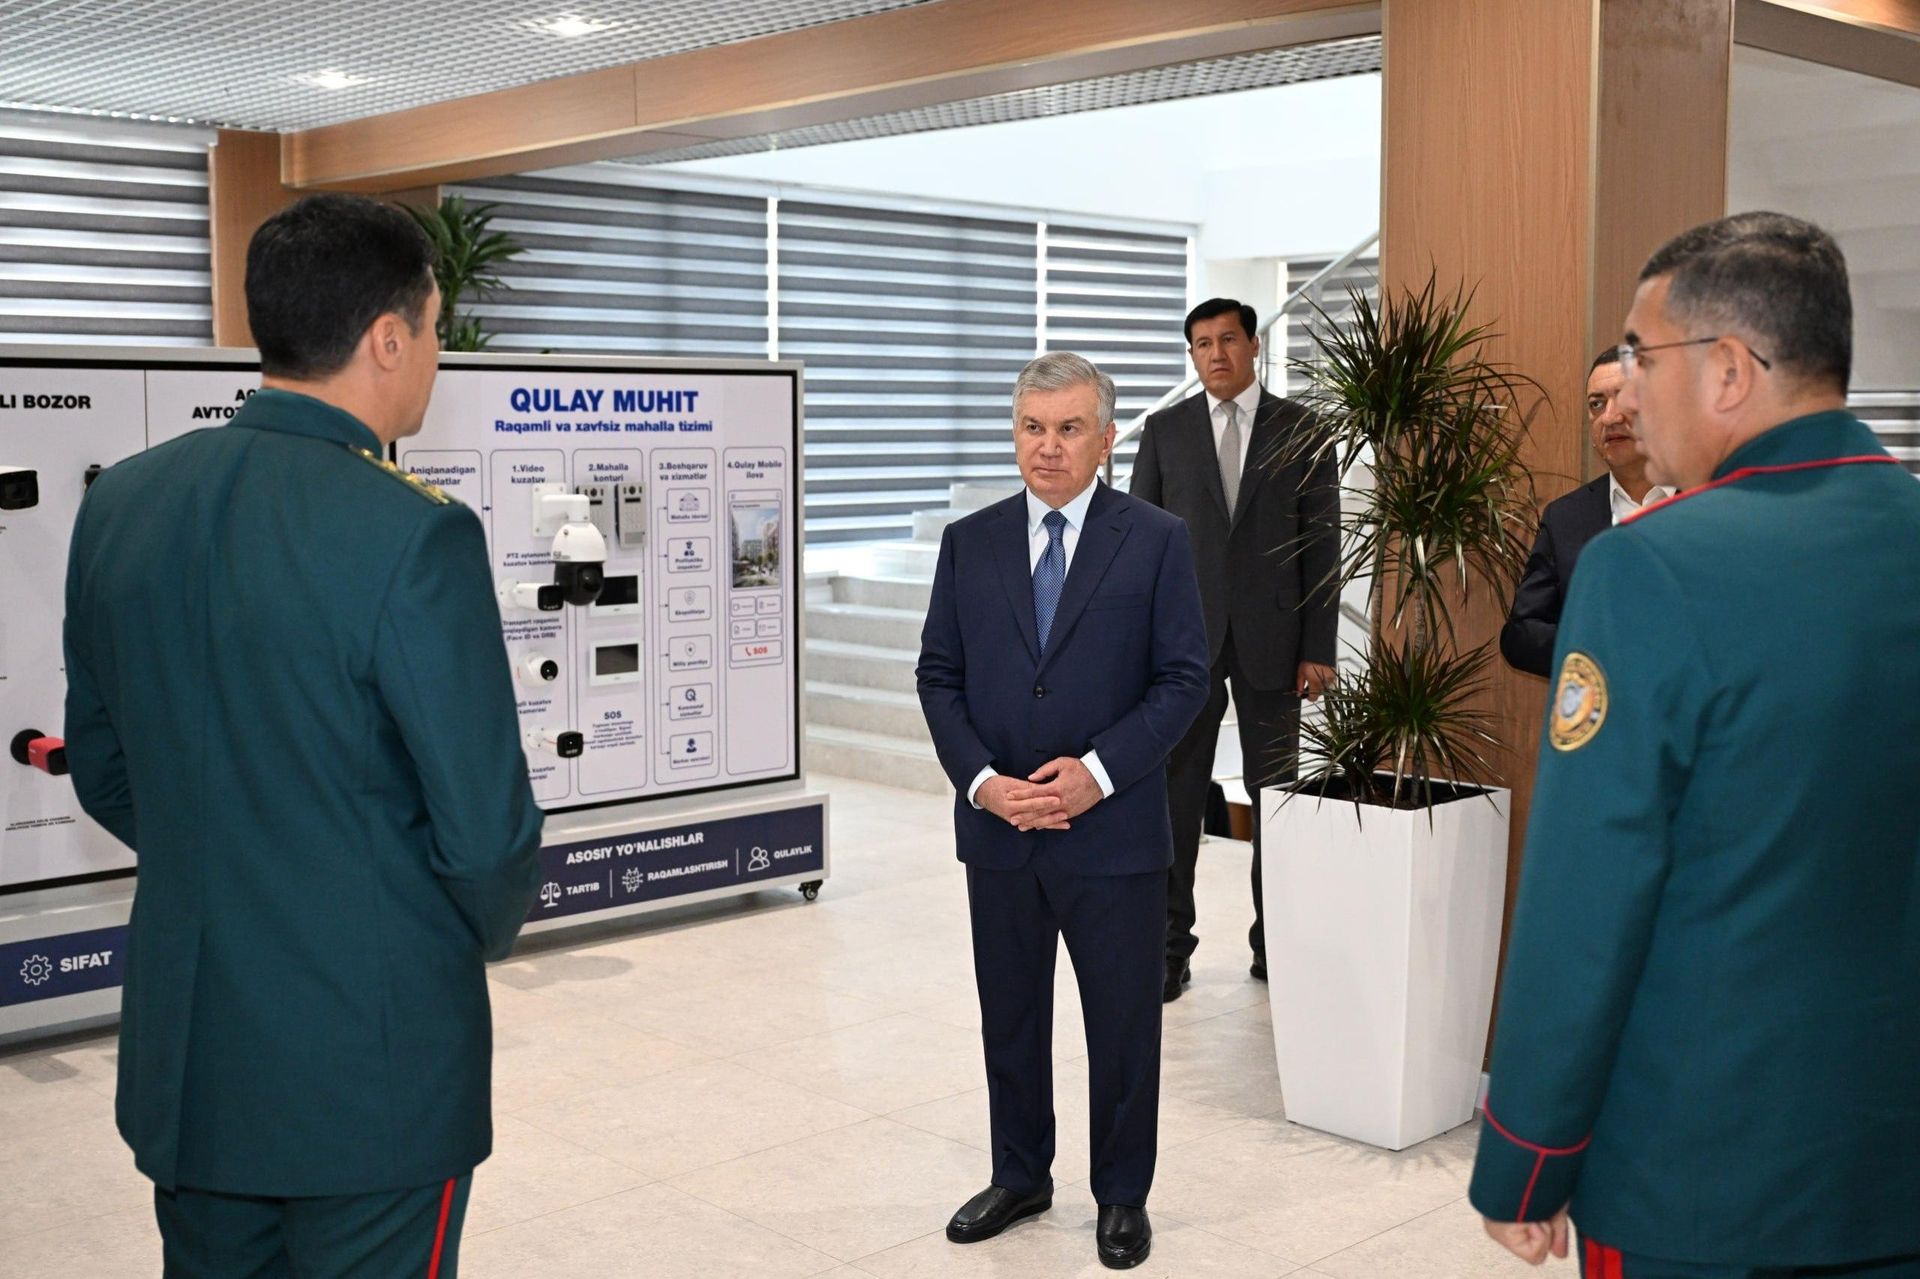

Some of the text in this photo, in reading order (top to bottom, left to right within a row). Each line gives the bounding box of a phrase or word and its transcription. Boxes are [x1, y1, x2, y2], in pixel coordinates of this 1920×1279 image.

[23, 395, 91, 409] BOZOR
[511, 388, 698, 413] QULAY MUHIT
[192, 406, 241, 419] AVTO
[495, 420, 713, 433] Raqamli va xavfsiz mahalla tizimi
[512, 465, 545, 473] 1.Video
[588, 463, 629, 472] 2.Mahalla
[659, 462, 708, 471] 3.Boshqaruv
[727, 461, 755, 470] 4.Qulay
[410, 466, 476, 476] Aniqlanadigan
[746, 471, 764, 479] ilova
[511, 475, 546, 484] kuzatuv
[593, 474, 624, 482] konturi
[672, 473, 707, 481] xizmatlar
[753, 647, 768, 655] SOS
[604, 711, 622, 720] SOS
[566, 832, 704, 865] ASOSIY YO'NALISHLAR
[566, 845, 812, 896] TARTIB RAQAMLASHTIRISH QULAYLIK
[60, 950, 113, 973] SIFAT
